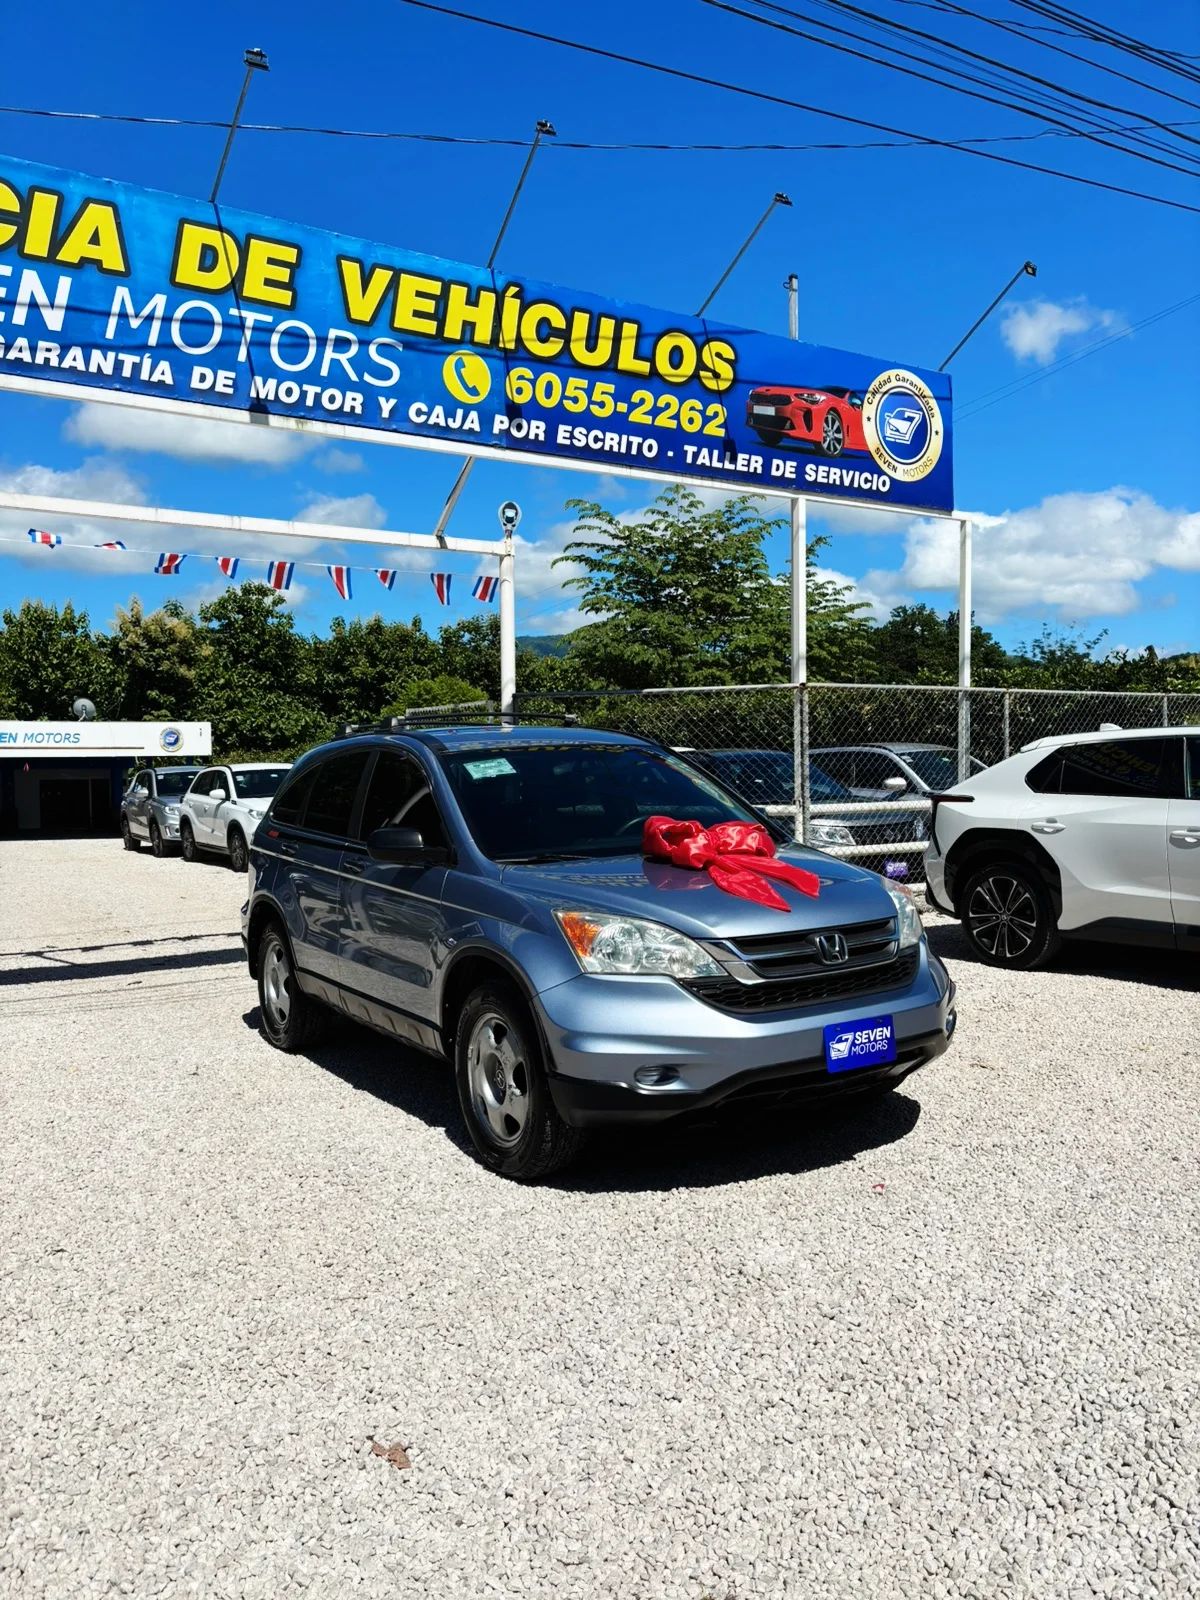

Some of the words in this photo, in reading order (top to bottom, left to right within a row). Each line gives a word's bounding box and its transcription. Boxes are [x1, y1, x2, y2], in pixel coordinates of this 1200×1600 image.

[0, 264, 72, 332] N
[105, 286, 403, 388] MOTORS
[174, 222, 299, 307] DE
[340, 258, 736, 392] VEHÍCULOS
[0, 336, 173, 386] ARANTÍA
[190, 366, 236, 394] DE
[250, 376, 363, 415] MOTOR
[377, 395, 399, 419] Y
[408, 402, 481, 432] CAJA
[492, 414, 546, 442] POR
[556, 424, 659, 459] ESCRITO
[683, 444, 764, 474] TALLER
[770, 458, 797, 478] DE
[803, 463, 891, 492] SERVICIO
[505, 366, 727, 438] 6055-2262
[866, 375, 892, 405] Calidad
[894, 373, 935, 419] Garantizada
[874, 446, 898, 473] SEVEN
[902, 456, 934, 478] MOTORS
[23, 732, 81, 744] MOTORS
[851, 1040, 888, 1056] MOTORS
[854, 1026, 891, 1044] SEVEN
